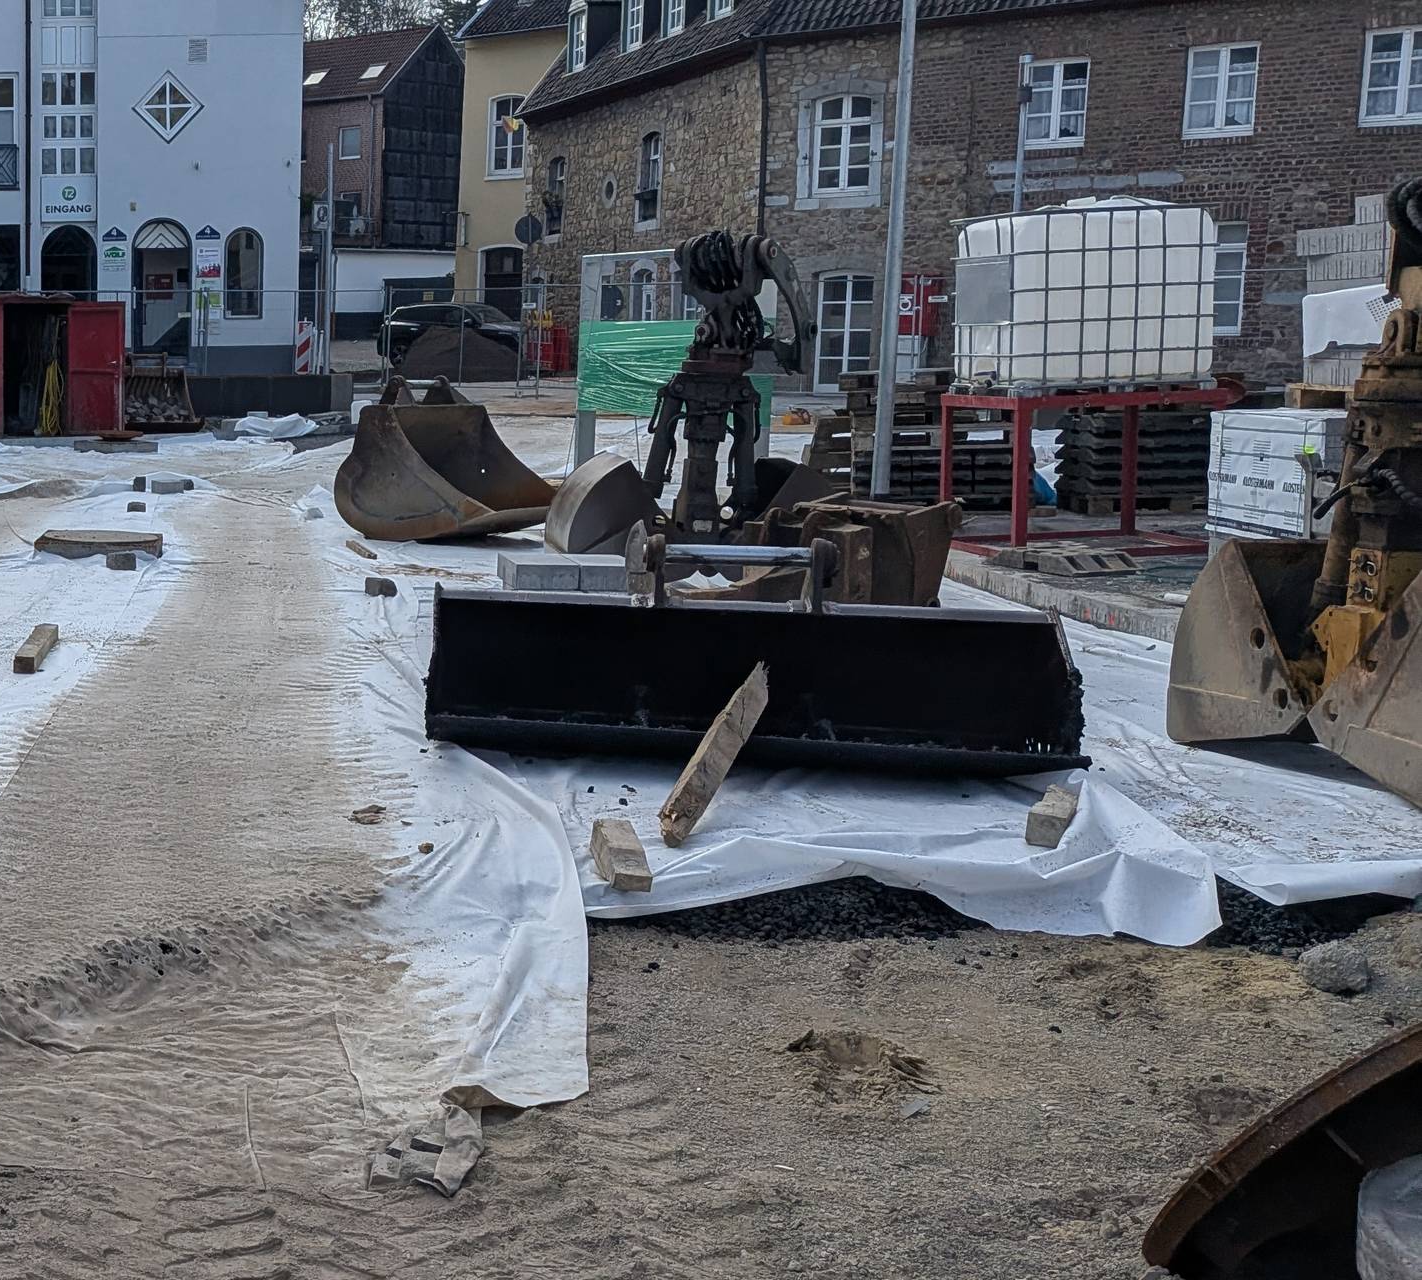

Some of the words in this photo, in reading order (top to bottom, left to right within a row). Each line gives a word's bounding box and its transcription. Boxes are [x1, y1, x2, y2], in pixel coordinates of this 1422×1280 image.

[45, 204, 92, 214] EINGANG
[111, 228, 117, 236] 4
[204, 227, 211, 235] 4
[1243, 476, 1275, 490] KLOSTERMANN
